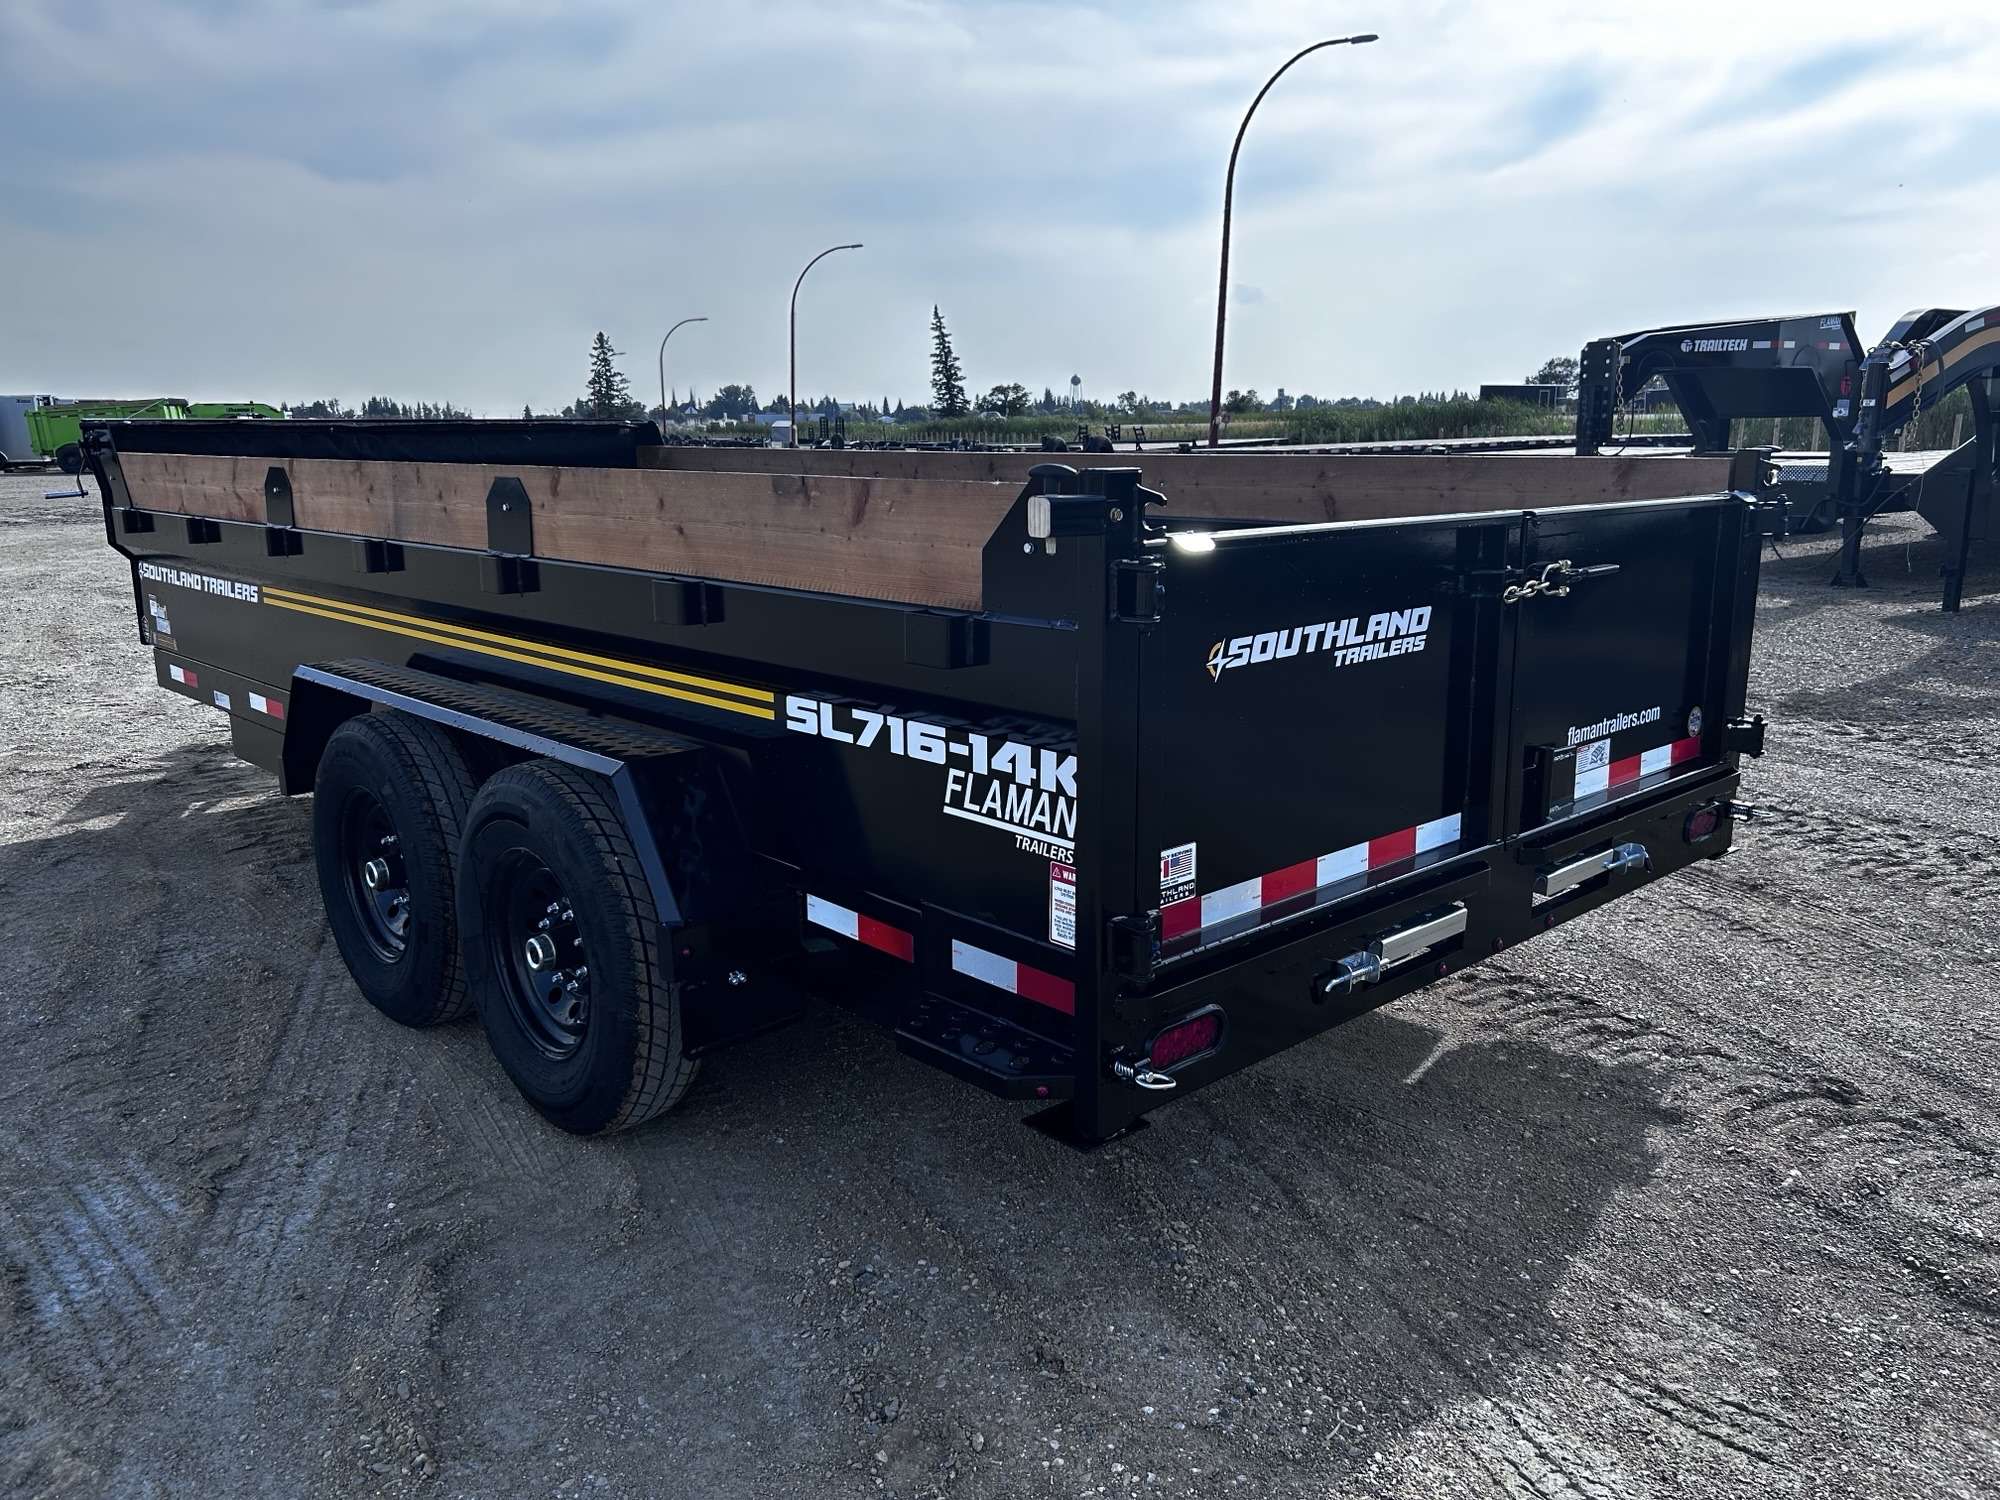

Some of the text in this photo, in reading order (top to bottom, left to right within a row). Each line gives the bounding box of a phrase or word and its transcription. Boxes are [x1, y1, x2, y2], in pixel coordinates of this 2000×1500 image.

[1694, 339, 1748, 352] TRAILTECH
[143, 562, 258, 603] SOUTHLAND TRAILERS
[1225, 606, 1432, 669] SOUTHLAND
[1333, 634, 1427, 667] TRAILERS
[1567, 706, 1661, 747] flamantrailers.com
[786, 695, 1077, 798] SL716-14K
[944, 768, 1077, 838] FLAMAN
[1015, 834, 1074, 864] TRAILERS
[1160, 891, 1189, 904] AILERS
[1161, 882, 1195, 897] THLAND
